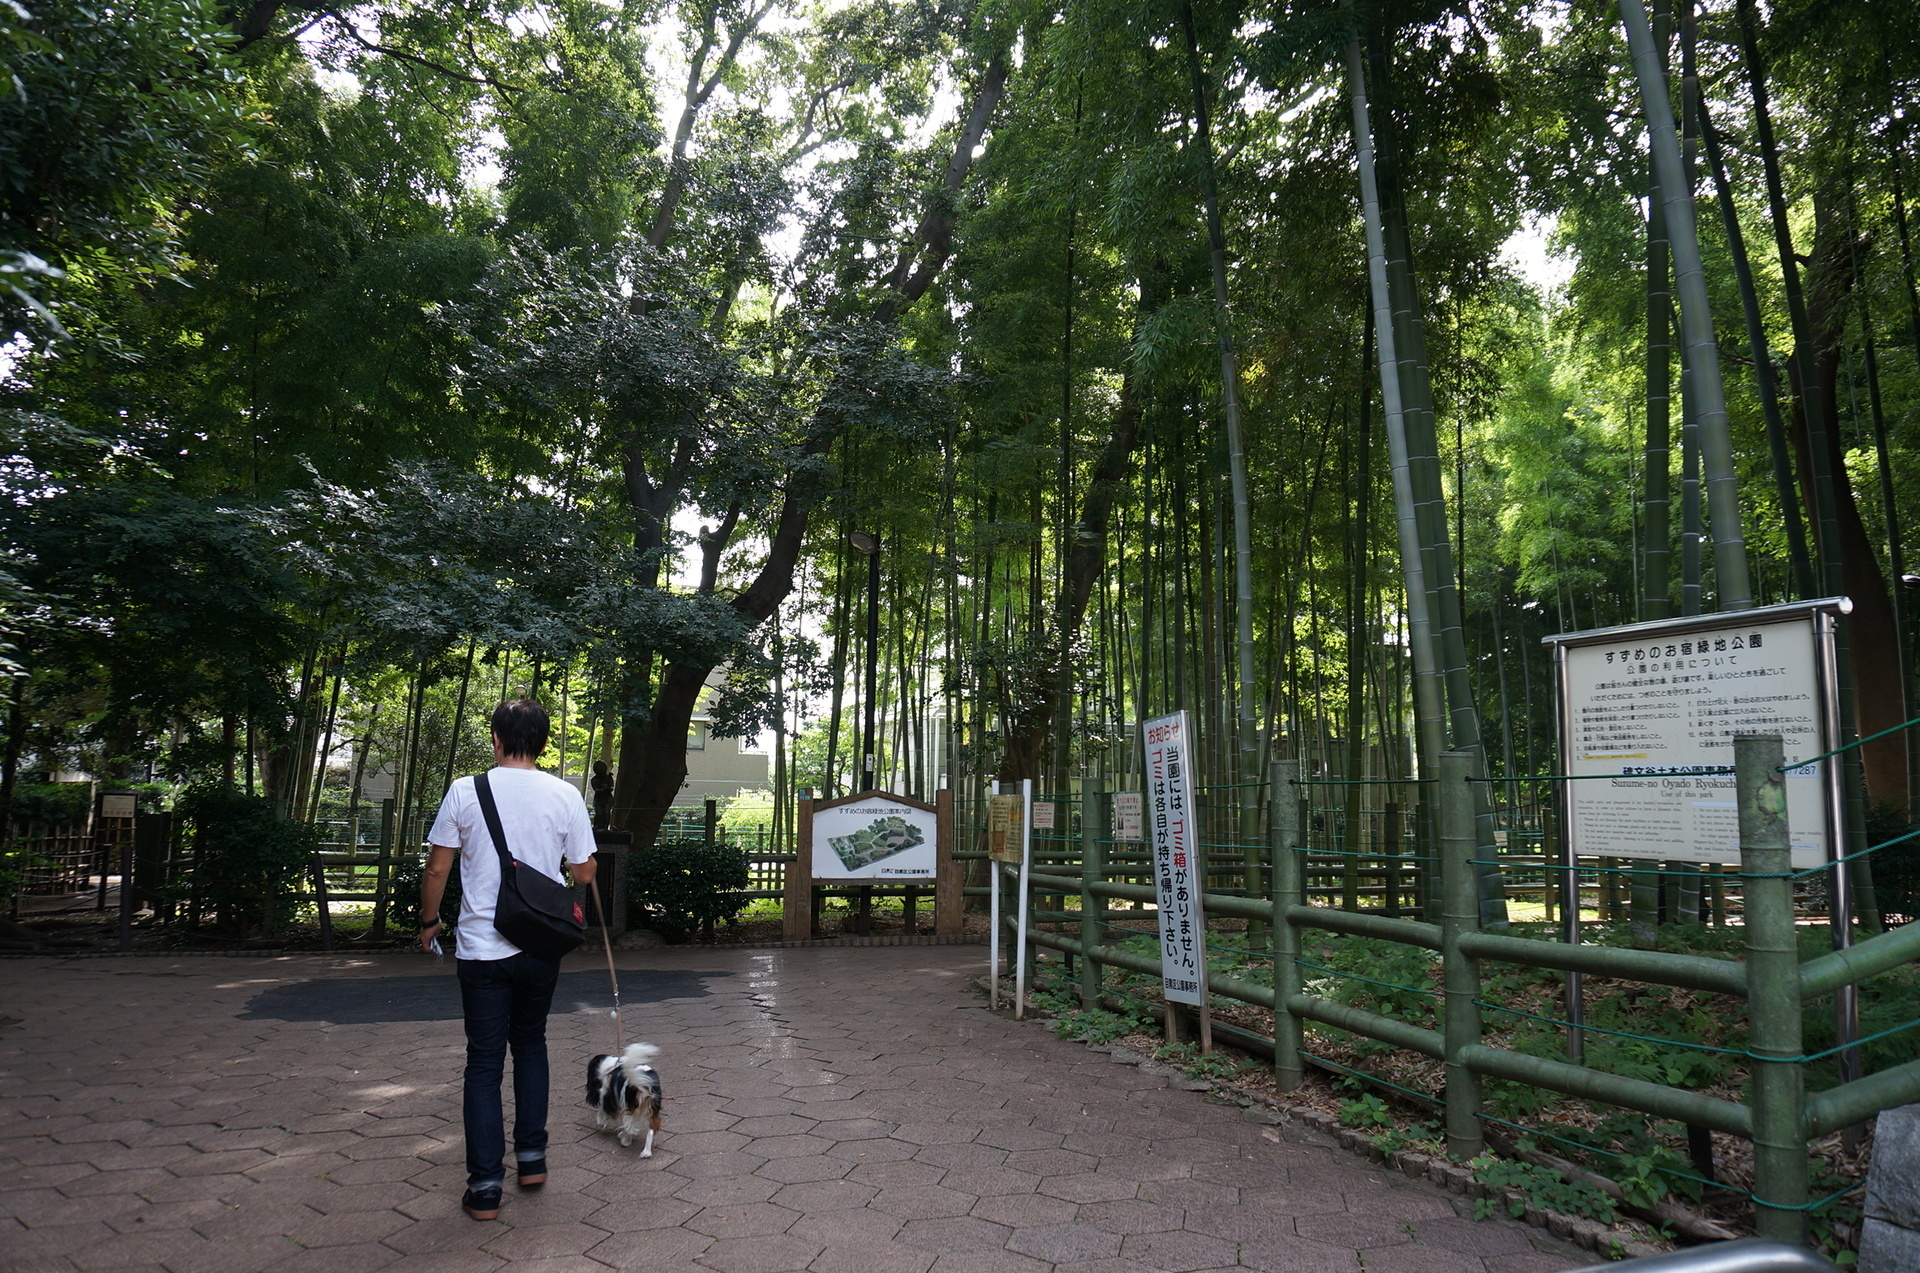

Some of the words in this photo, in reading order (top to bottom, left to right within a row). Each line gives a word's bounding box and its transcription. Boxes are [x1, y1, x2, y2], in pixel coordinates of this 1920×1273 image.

[1605, 633, 1763, 664] すずめのお宿緑地公園
[1627, 656, 1738, 674] 公園の利用について
[1147, 721, 1180, 745] お知らせ
[1612, 778, 1658, 788] Suzume-no
[1662, 778, 1691, 790] Oyado
[1661, 790, 1673, 798] Use
[1685, 791, 1696, 799] this
[1699, 791, 1714, 800] park
[1151, 748, 1179, 966] ゴミは各自が持ち帰り下さい。
[1166, 745, 1195, 976] 当園には、ゴミ箱がありません。
[1165, 977, 1198, 994] 目黒区公園事務所
